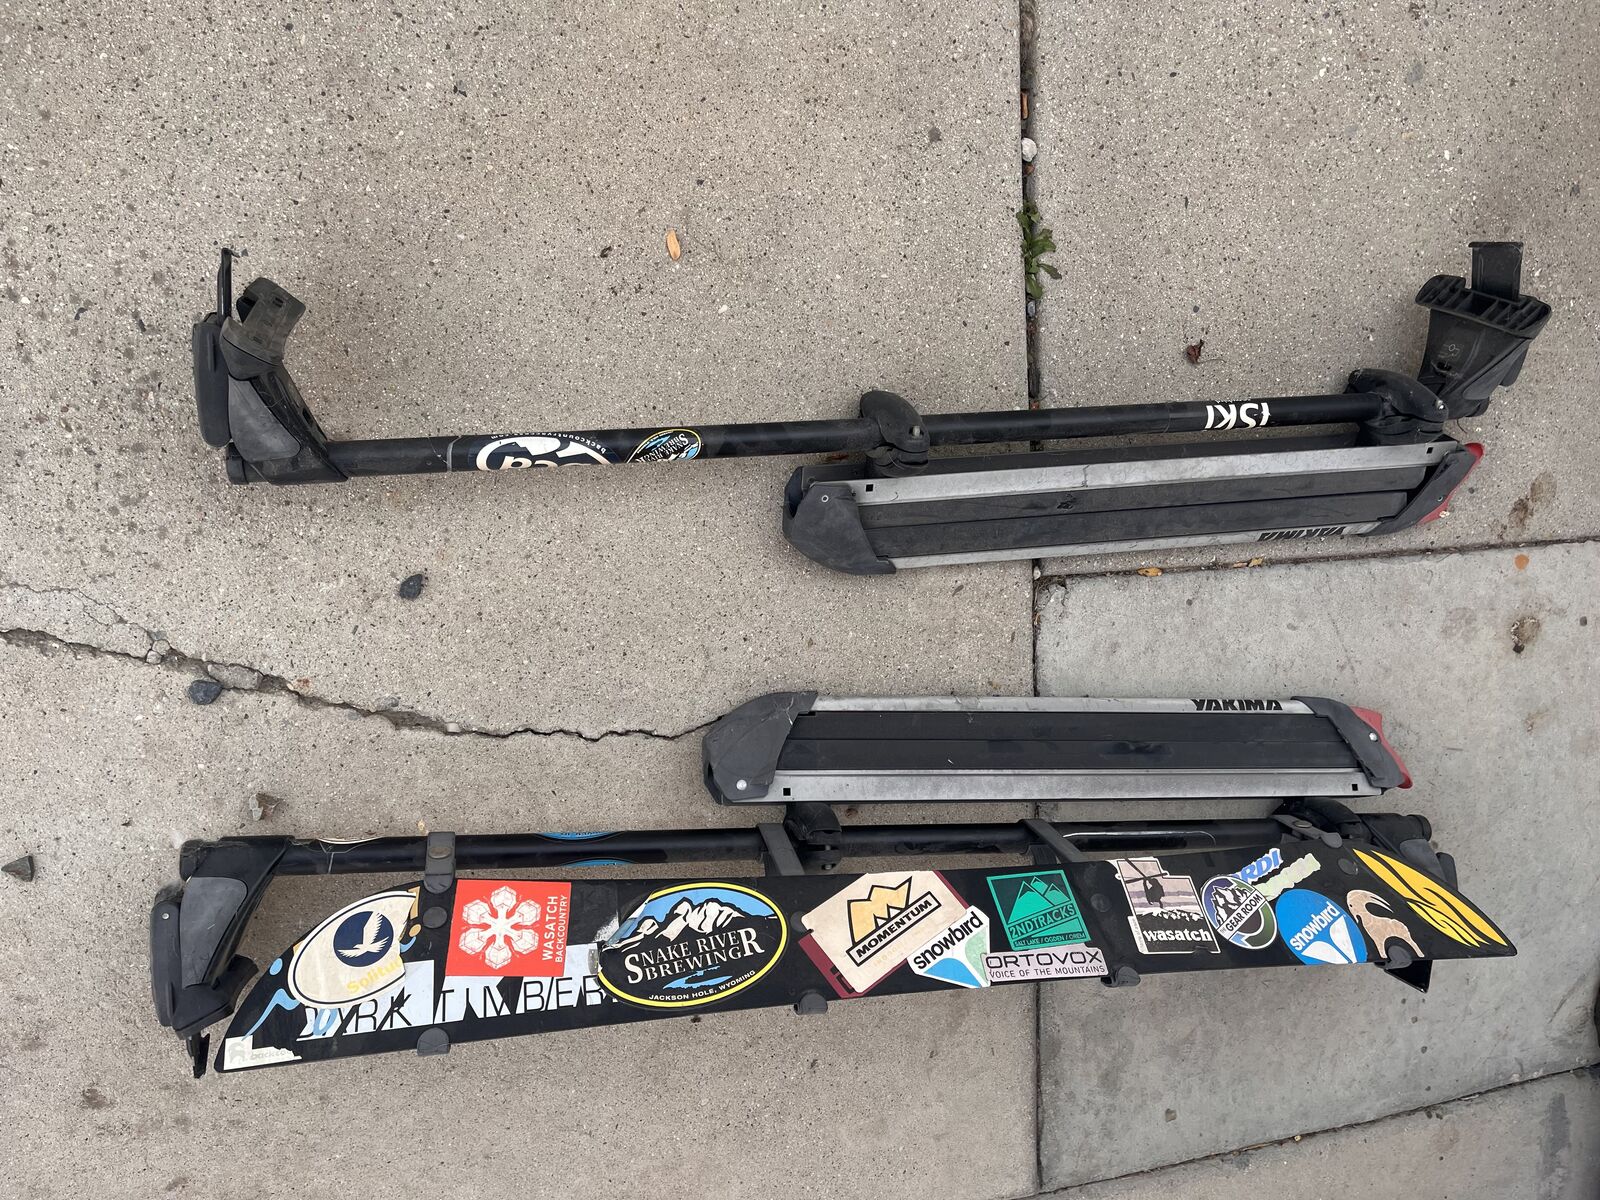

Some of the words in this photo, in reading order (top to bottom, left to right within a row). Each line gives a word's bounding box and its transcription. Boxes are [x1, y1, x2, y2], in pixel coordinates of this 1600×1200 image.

[1257, 526, 1346, 542] YAKIMA
[1190, 698, 1283, 711] YAKIMA
[541, 895, 559, 961] WASATCH
[555, 894, 568, 963] BACKCOUNTRY
[856, 899, 933, 958] MOMENTUM
[1225, 912, 1245, 932] GEAR
[1241, 893, 1263, 916] ROOM
[1289, 901, 1340, 951] snowbird
[913, 911, 984, 970] snowbird
[1142, 928, 1213, 942] wasatch
[624, 941, 692, 984] SNAKE
[696, 927, 765, 957] RIVER
[645, 947, 742, 981] BREWING
[985, 951, 1103, 969] ORTOVOX
[989, 969, 1016, 979] VOICE
[1019, 968, 1031, 978] OF
[1034, 967, 1052, 976] THE
[1054, 965, 1106, 975] MOUNTAINS
[691, 988, 718, 999] HOLE,
[718, 970, 756, 991] WYOMING
